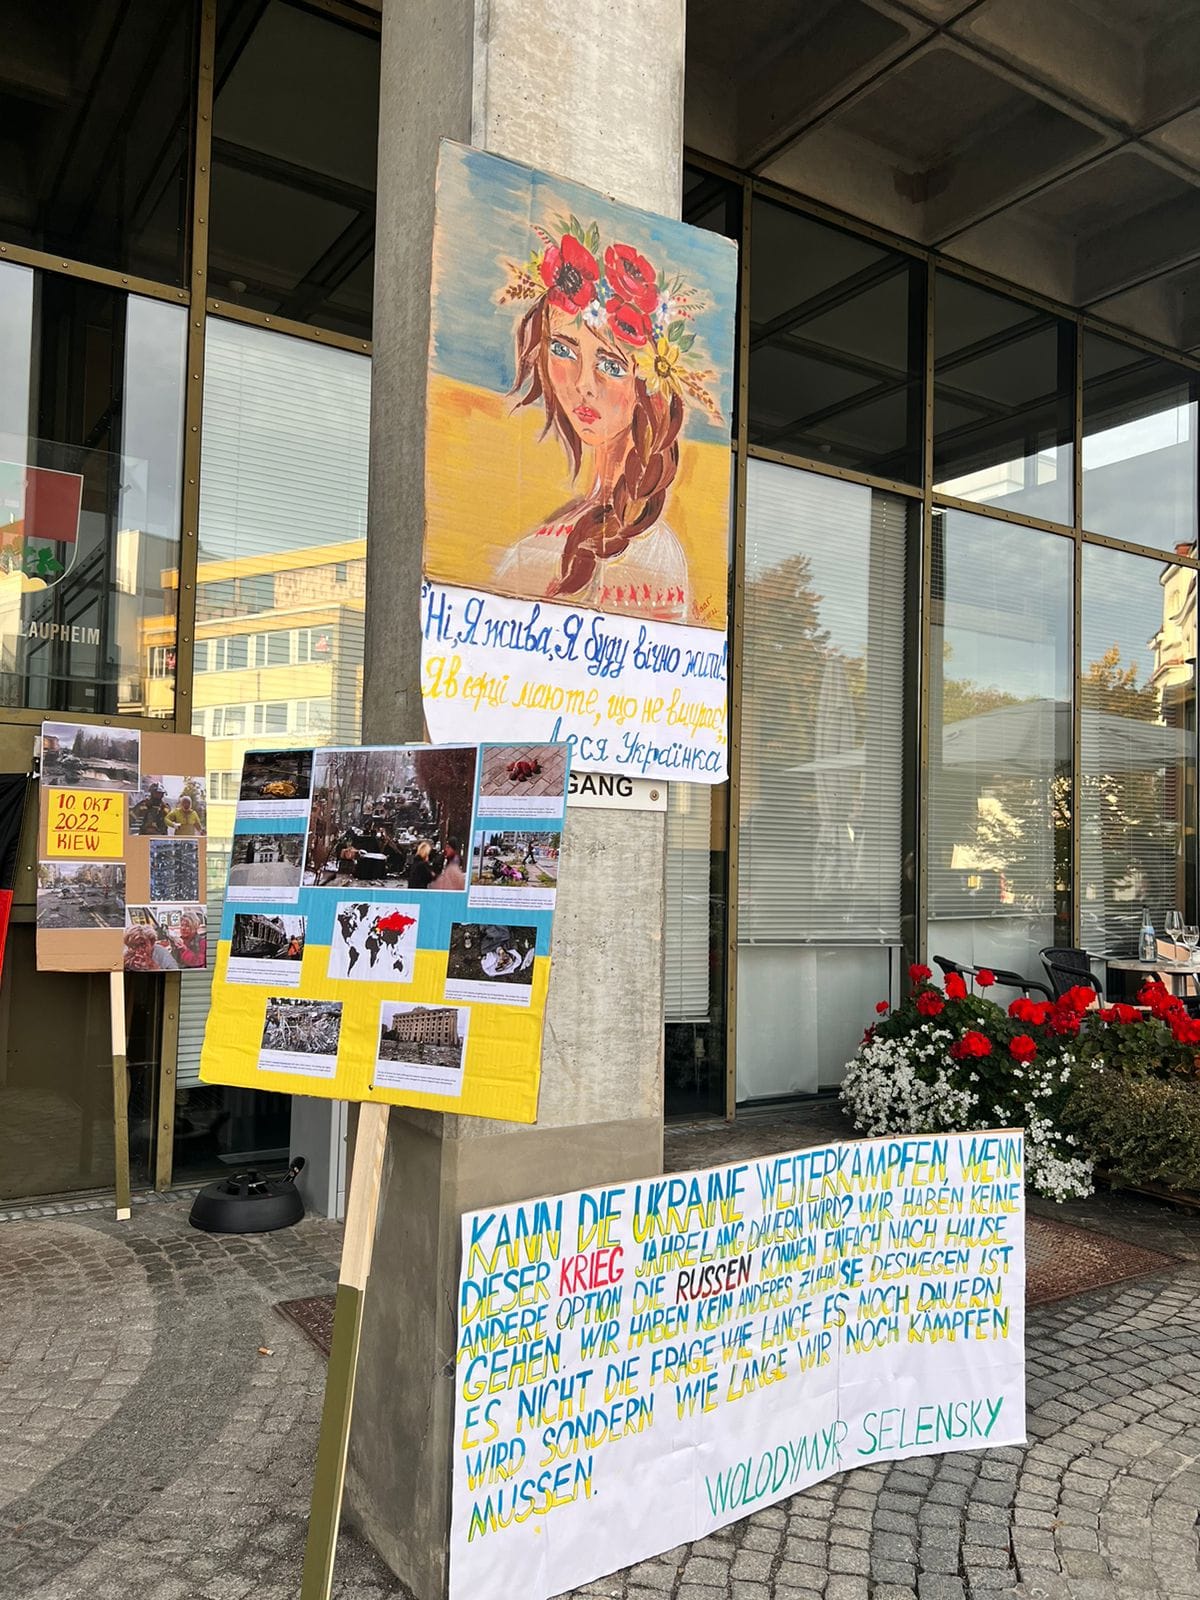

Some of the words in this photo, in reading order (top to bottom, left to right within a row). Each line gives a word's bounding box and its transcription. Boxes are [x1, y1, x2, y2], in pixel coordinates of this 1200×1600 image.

[21, 620, 100, 645] LAUPHEIM
[584, 616, 629, 678] буду
[633, 625, 680, 673] вічно
[607, 694, 637, 726] що
[641, 696, 664, 723] не
[616, 731, 722, 774] Українка
[83, 797, 113, 811] OKT
[567, 773, 634, 797] GANG
[55, 814, 99, 832] 2022
[57, 834, 100, 851] KIEW
[468, 1200, 563, 1278] KANN
[578, 1189, 625, 1252] DIE
[633, 1166, 748, 1243] UKRAINE
[959, 1137, 1022, 1184] WENN
[461, 1261, 550, 1328] DIESER
[559, 1246, 624, 1297] KRIEG
[747, 1204, 804, 1252] DAUERN
[808, 1194, 854, 1233] WIRD?
[859, 1191, 893, 1224] WIR
[901, 1187, 963, 1217] HABEN
[970, 1183, 1020, 1214] KEINE
[456, 1304, 549, 1364] ANDERE
[556, 1285, 623, 1330] OPTION
[632, 1276, 666, 1316] DIE
[675, 1254, 752, 1305] RUSSEN
[822, 1222, 882, 1264] EINFACH
[888, 1218, 937, 1249] NACH
[944, 1216, 1008, 1248] HAUSE
[463, 1333, 567, 1402] GEHEN.
[580, 1320, 620, 1361] WIR
[628, 1304, 690, 1350] HABEN
[695, 1292, 733, 1332] KEIN
[736, 1276, 793, 1318] ANDERES
[869, 1249, 970, 1282] DESWEGEN
[979, 1246, 1014, 1275] IST
[461, 1398, 501, 1450] ES
[516, 1369, 593, 1434] NICHT
[604, 1356, 641, 1403] DIE
[649, 1335, 717, 1387] FRAGE,
[721, 1321, 754, 1364] WIE
[760, 1301, 813, 1350] LANGE
[822, 1291, 850, 1329] ES
[857, 1284, 910, 1322] NOCH
[916, 1276, 1003, 1312] DAUERN
[466, 1437, 527, 1492] WIRD
[540, 1392, 655, 1467] SONDERN
[676, 1372, 719, 1421] WIE
[726, 1348, 788, 1402] LANGE
[798, 1331, 832, 1372] WIR
[846, 1316, 899, 1354] NOCH
[907, 1306, 1009, 1344] KÄMPFEN
[705, 1420, 848, 1516] WOLODYMYR
[857, 1397, 1004, 1455] SELENSKY
